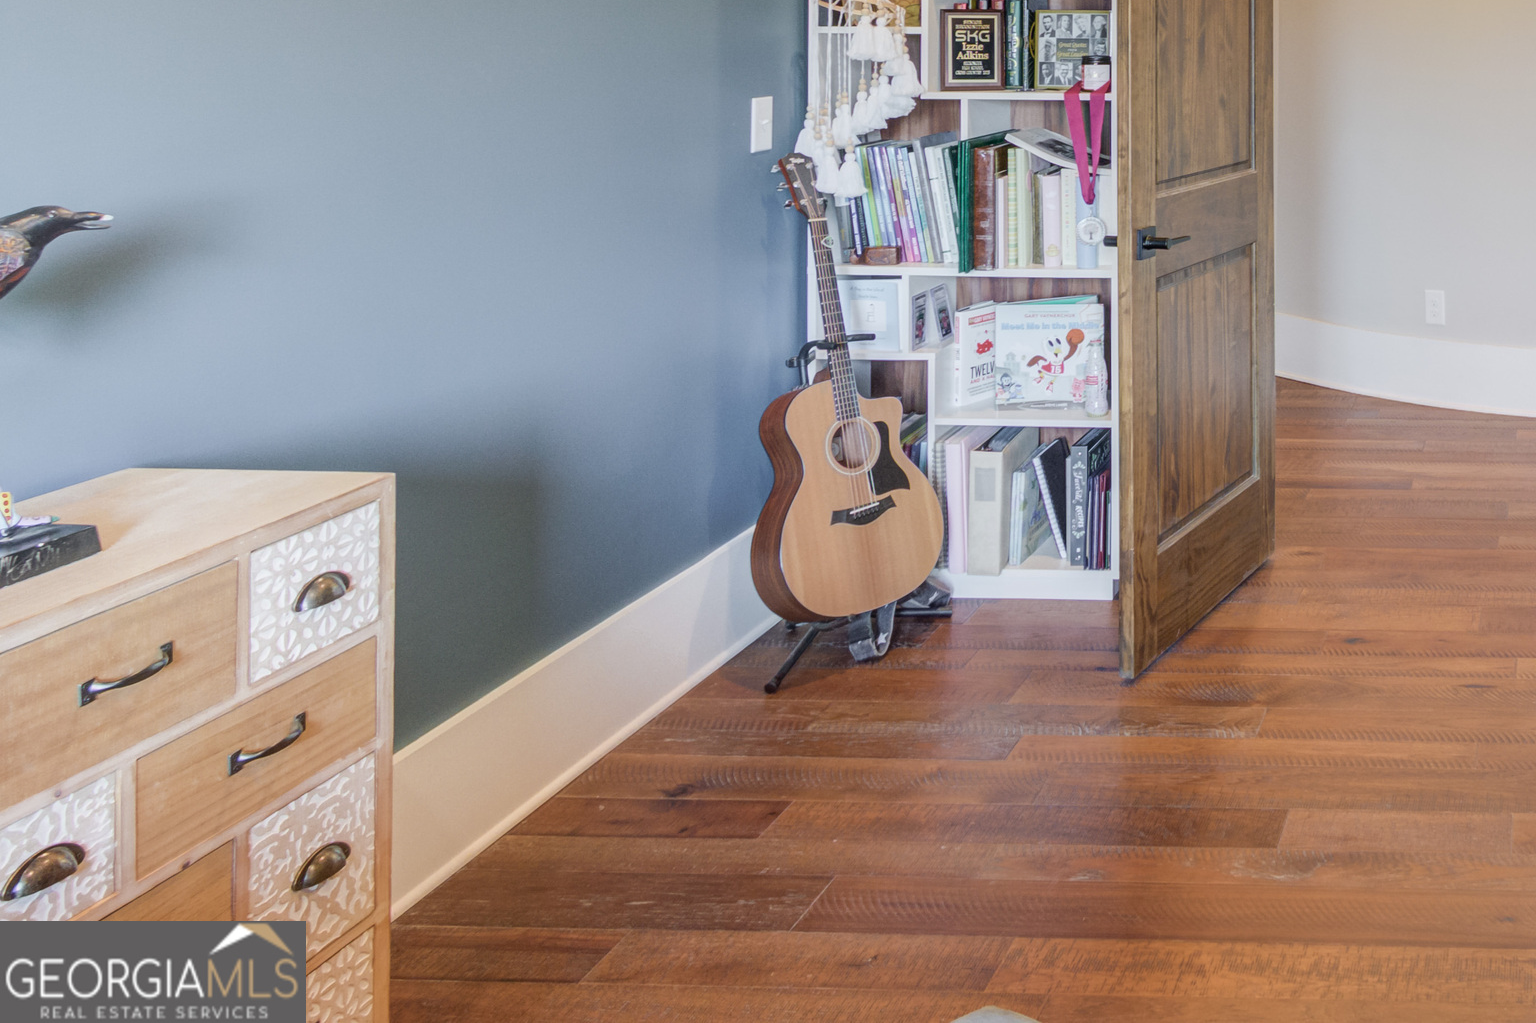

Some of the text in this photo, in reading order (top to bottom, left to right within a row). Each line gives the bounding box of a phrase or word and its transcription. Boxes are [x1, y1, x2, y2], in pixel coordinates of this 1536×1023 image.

[955, 30, 990, 43] SKG
[962, 42, 984, 51] Izzie
[956, 51, 989, 60] Adkins
[970, 360, 995, 379] TWELV
[1050, 366, 1061, 374] 15
